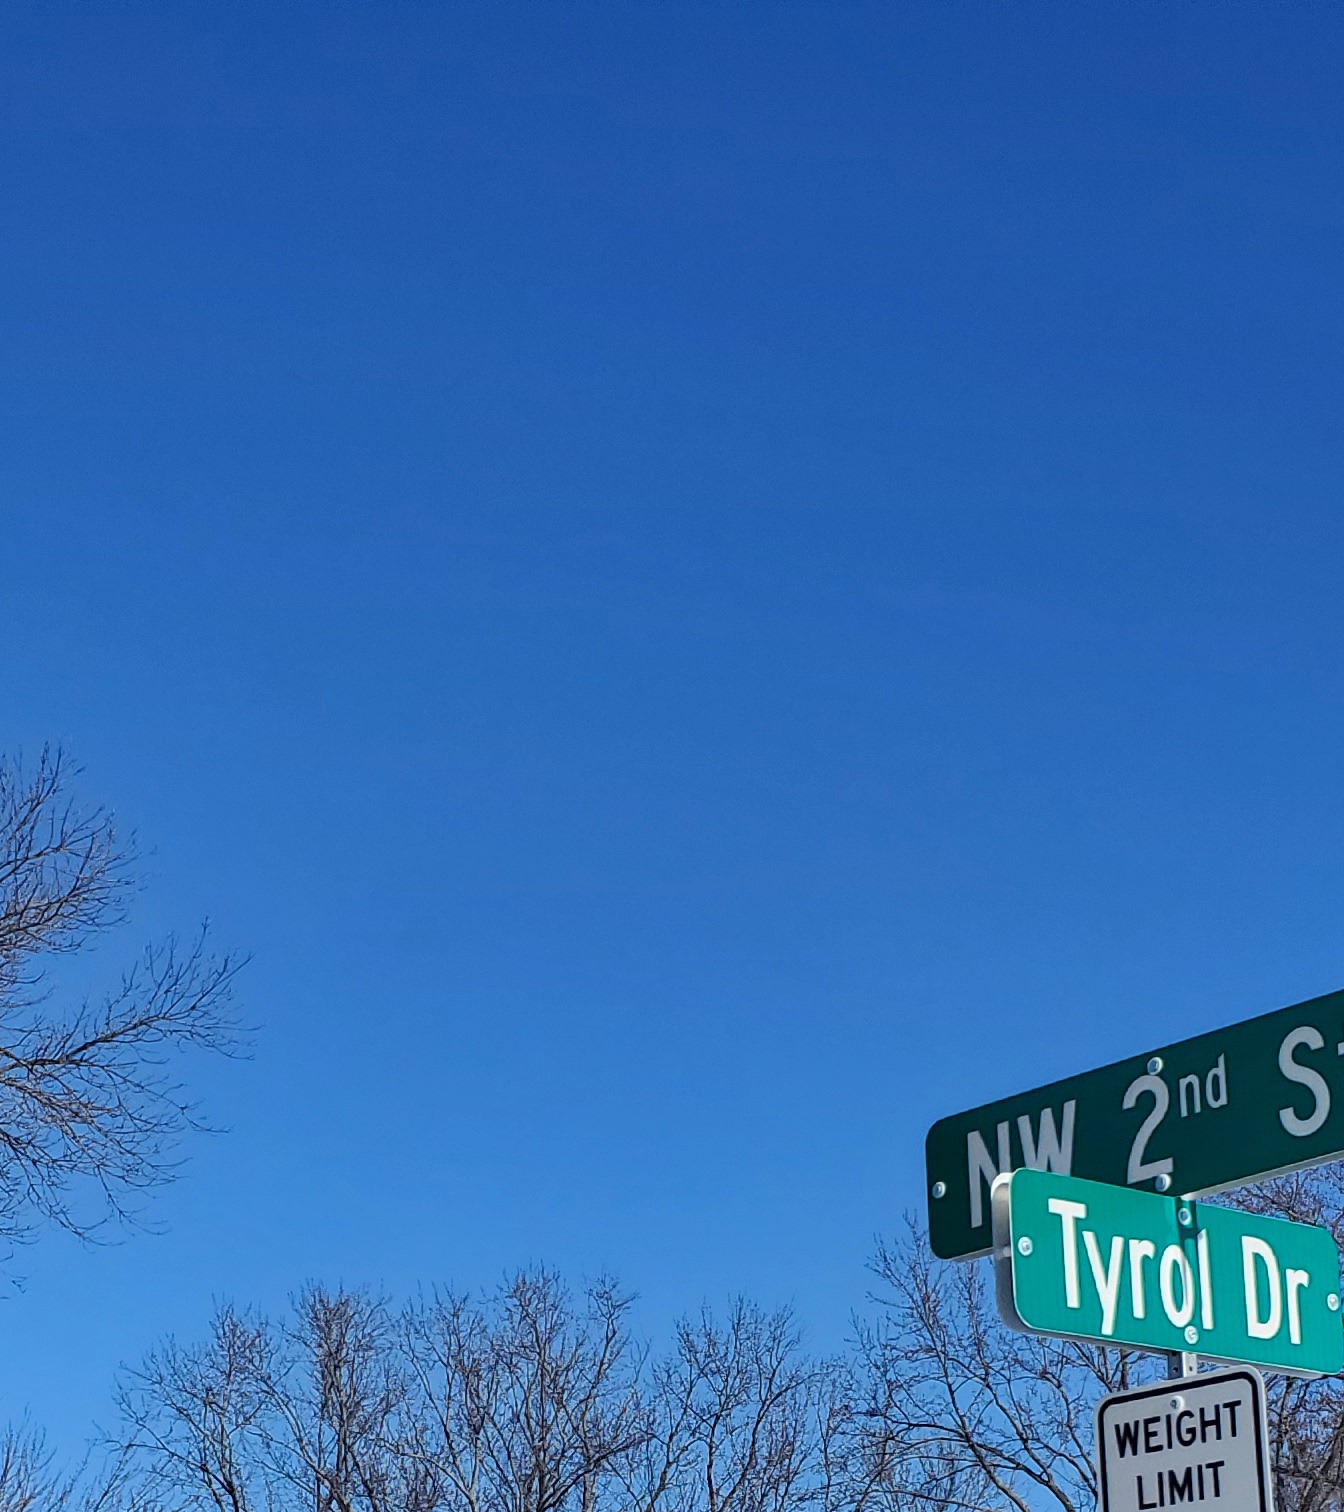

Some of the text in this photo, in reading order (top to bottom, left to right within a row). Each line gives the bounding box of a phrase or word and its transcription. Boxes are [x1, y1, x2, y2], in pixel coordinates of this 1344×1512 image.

[967, 1099, 1076, 1228] NW
[1122, 1053, 1228, 1185] 2nd
[1048, 1198, 1309, 1344] Tyrol Dr
[1114, 1400, 1242, 1458] WEIGHT
[1136, 1461, 1224, 1510] LIMIT
